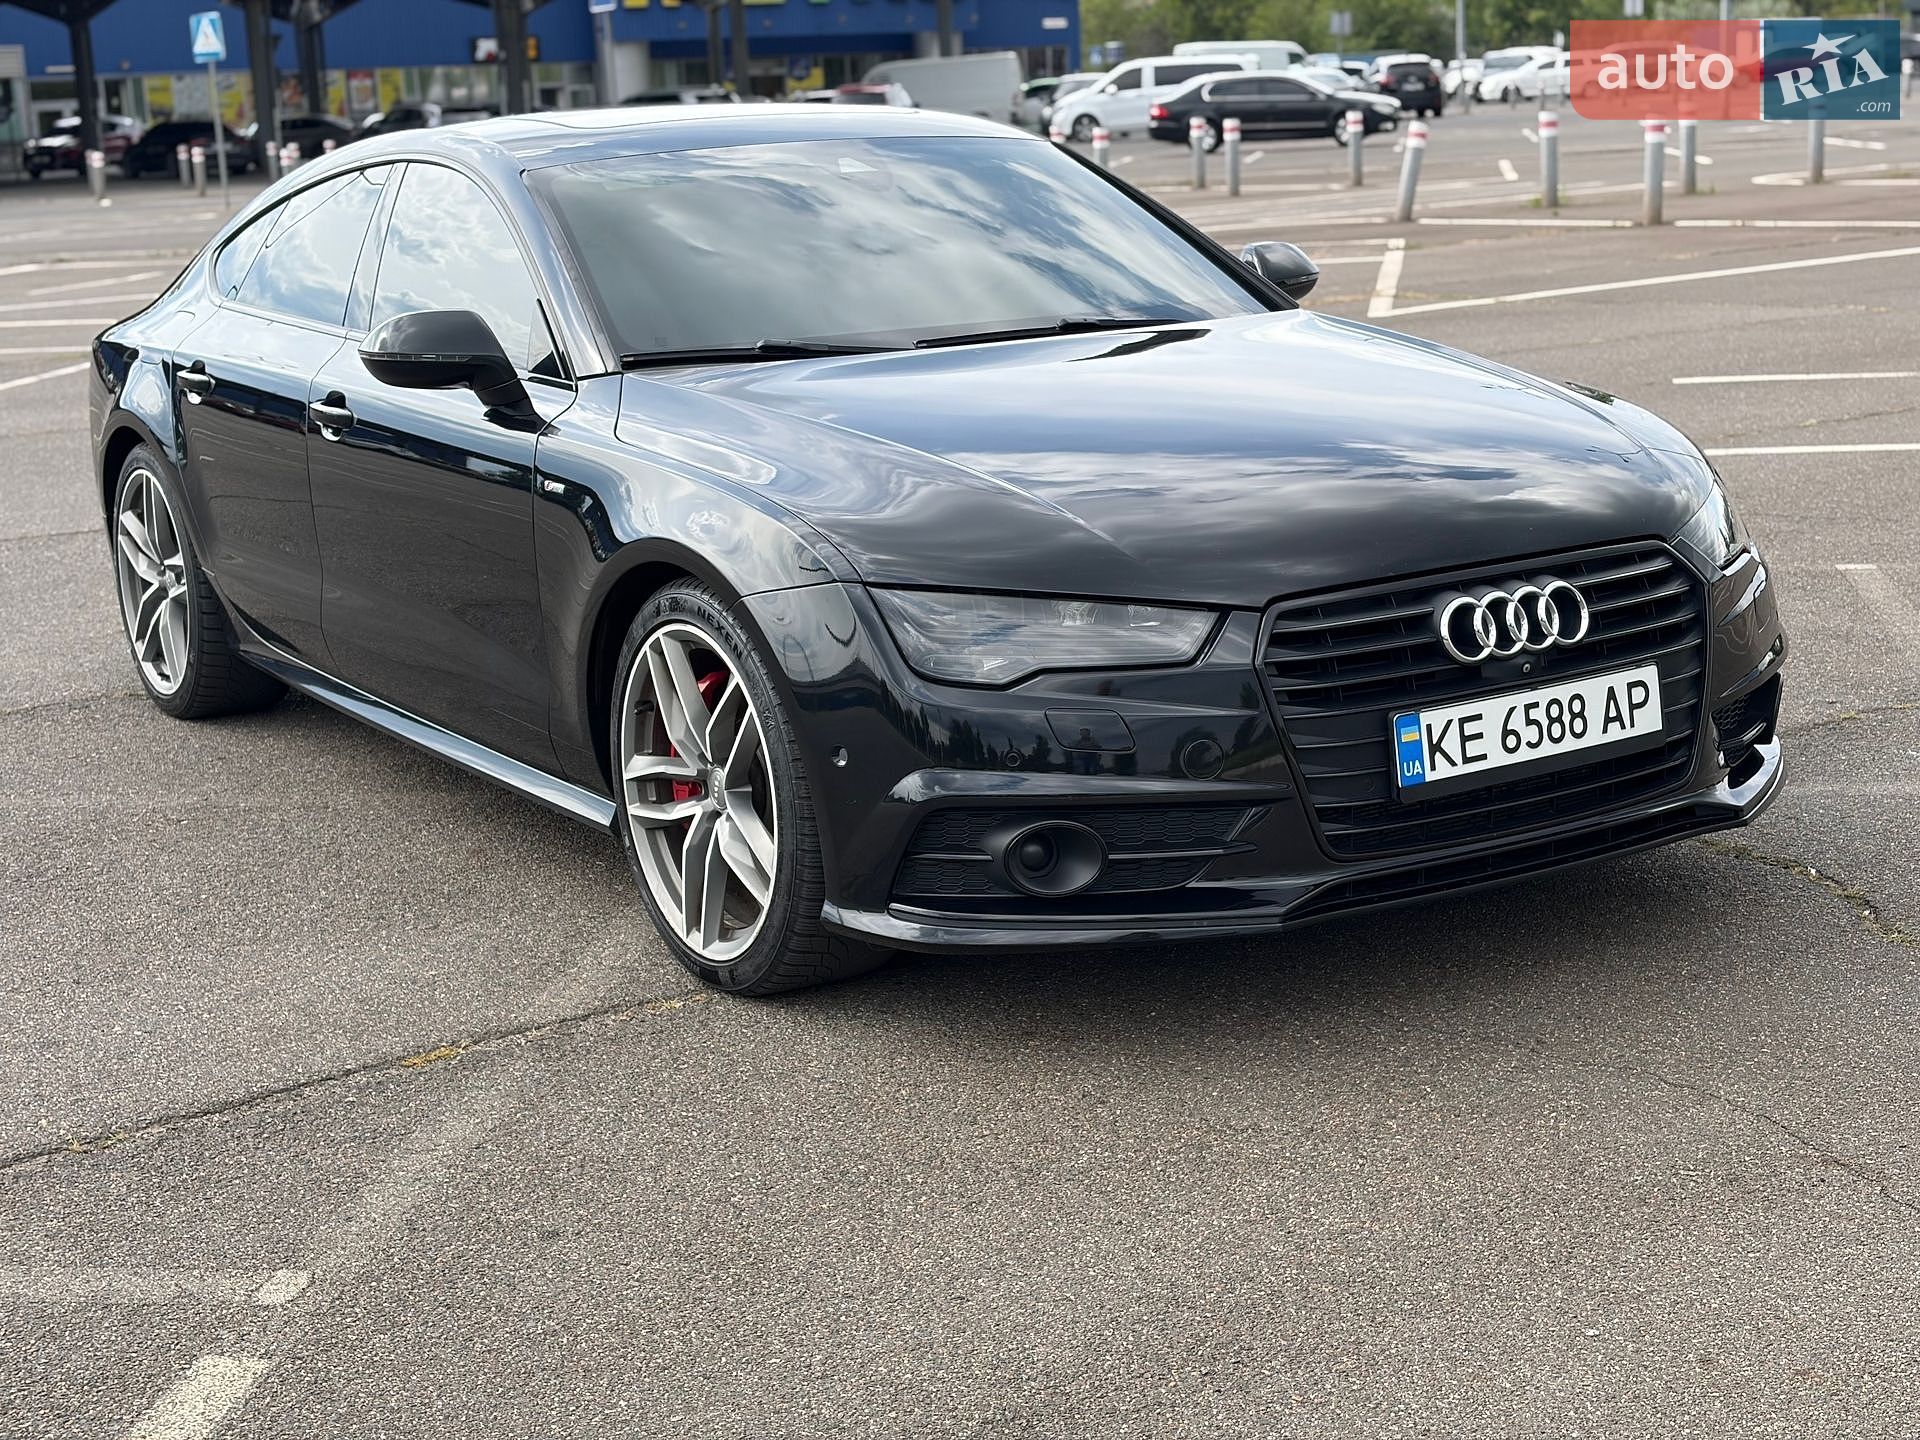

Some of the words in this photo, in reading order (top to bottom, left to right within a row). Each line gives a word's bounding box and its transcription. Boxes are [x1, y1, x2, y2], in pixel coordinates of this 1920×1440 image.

[696, 606, 743, 660] NEXEN
[1425, 713, 1488, 772] KE
[1500, 693, 1588, 754] 6588
[1601, 679, 1650, 735] AP
[1403, 759, 1423, 777] UA
